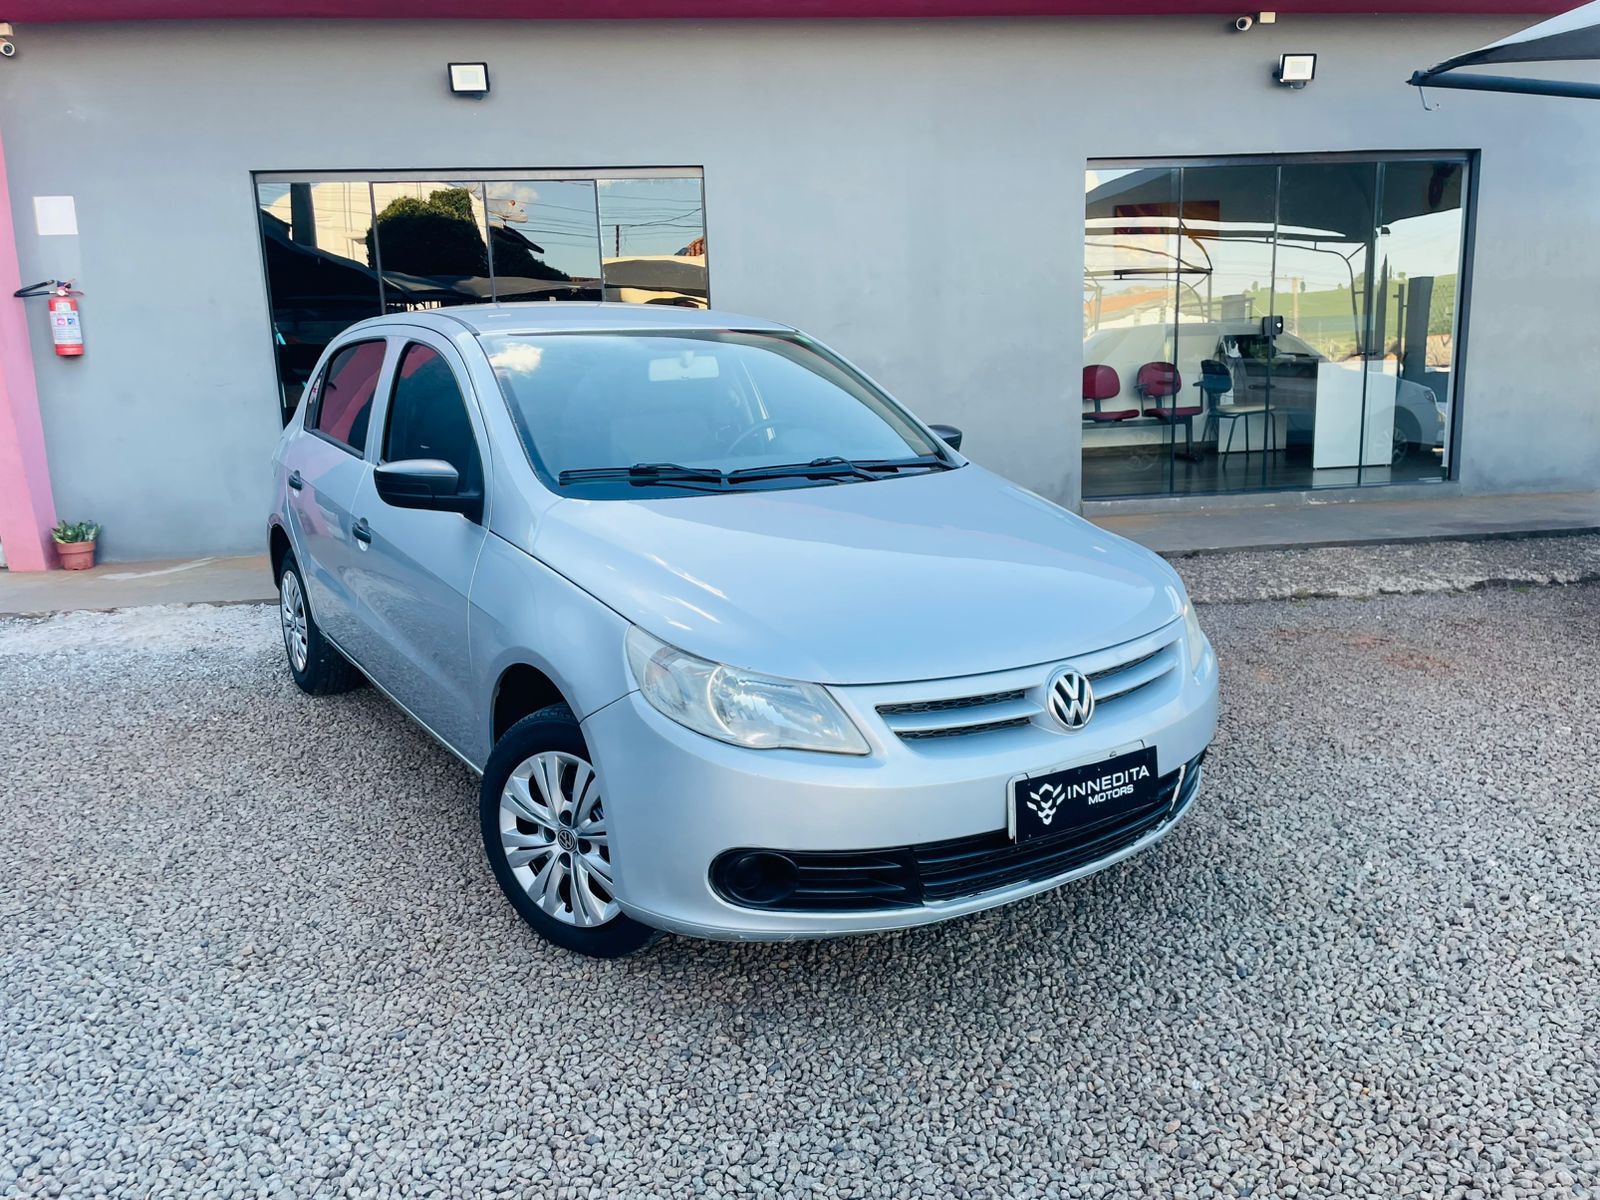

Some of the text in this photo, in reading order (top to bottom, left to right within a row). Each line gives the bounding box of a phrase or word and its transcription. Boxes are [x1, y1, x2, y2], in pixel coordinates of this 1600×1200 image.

[1051, 671, 1092, 727] VW
[1067, 765, 1149, 800] INNEDITA
[1088, 784, 1134, 805] MOTORS
[558, 831, 576, 850] VW
